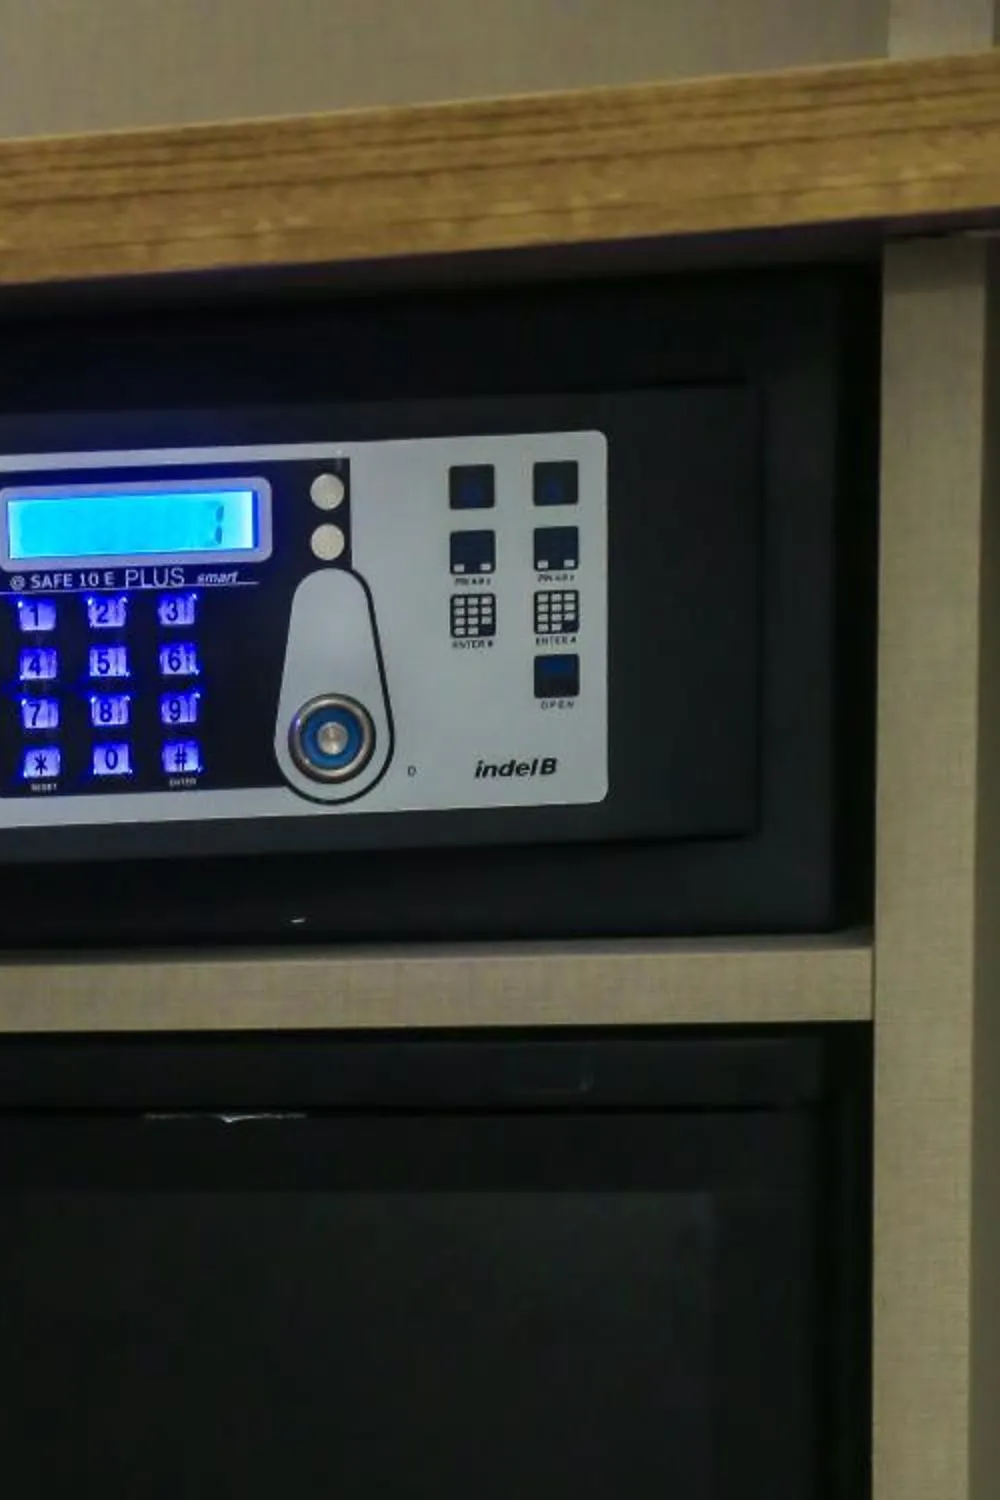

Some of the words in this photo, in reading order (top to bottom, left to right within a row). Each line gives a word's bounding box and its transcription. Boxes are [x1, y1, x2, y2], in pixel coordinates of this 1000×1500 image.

[29, 572, 73, 589] SAFE
[79, 572, 99, 587] 10
[104, 570, 115, 586] E
[124, 567, 185, 588] PLUS
[95, 603, 109, 624] 2
[165, 600, 178, 622] 3
[28, 654, 42, 676] 4
[99, 652, 111, 675] 5
[167, 649, 182, 673] 6
[31, 702, 43, 727] 7
[99, 700, 113, 723] 8
[168, 698, 182, 722] 9
[104, 748, 118, 770] 0
